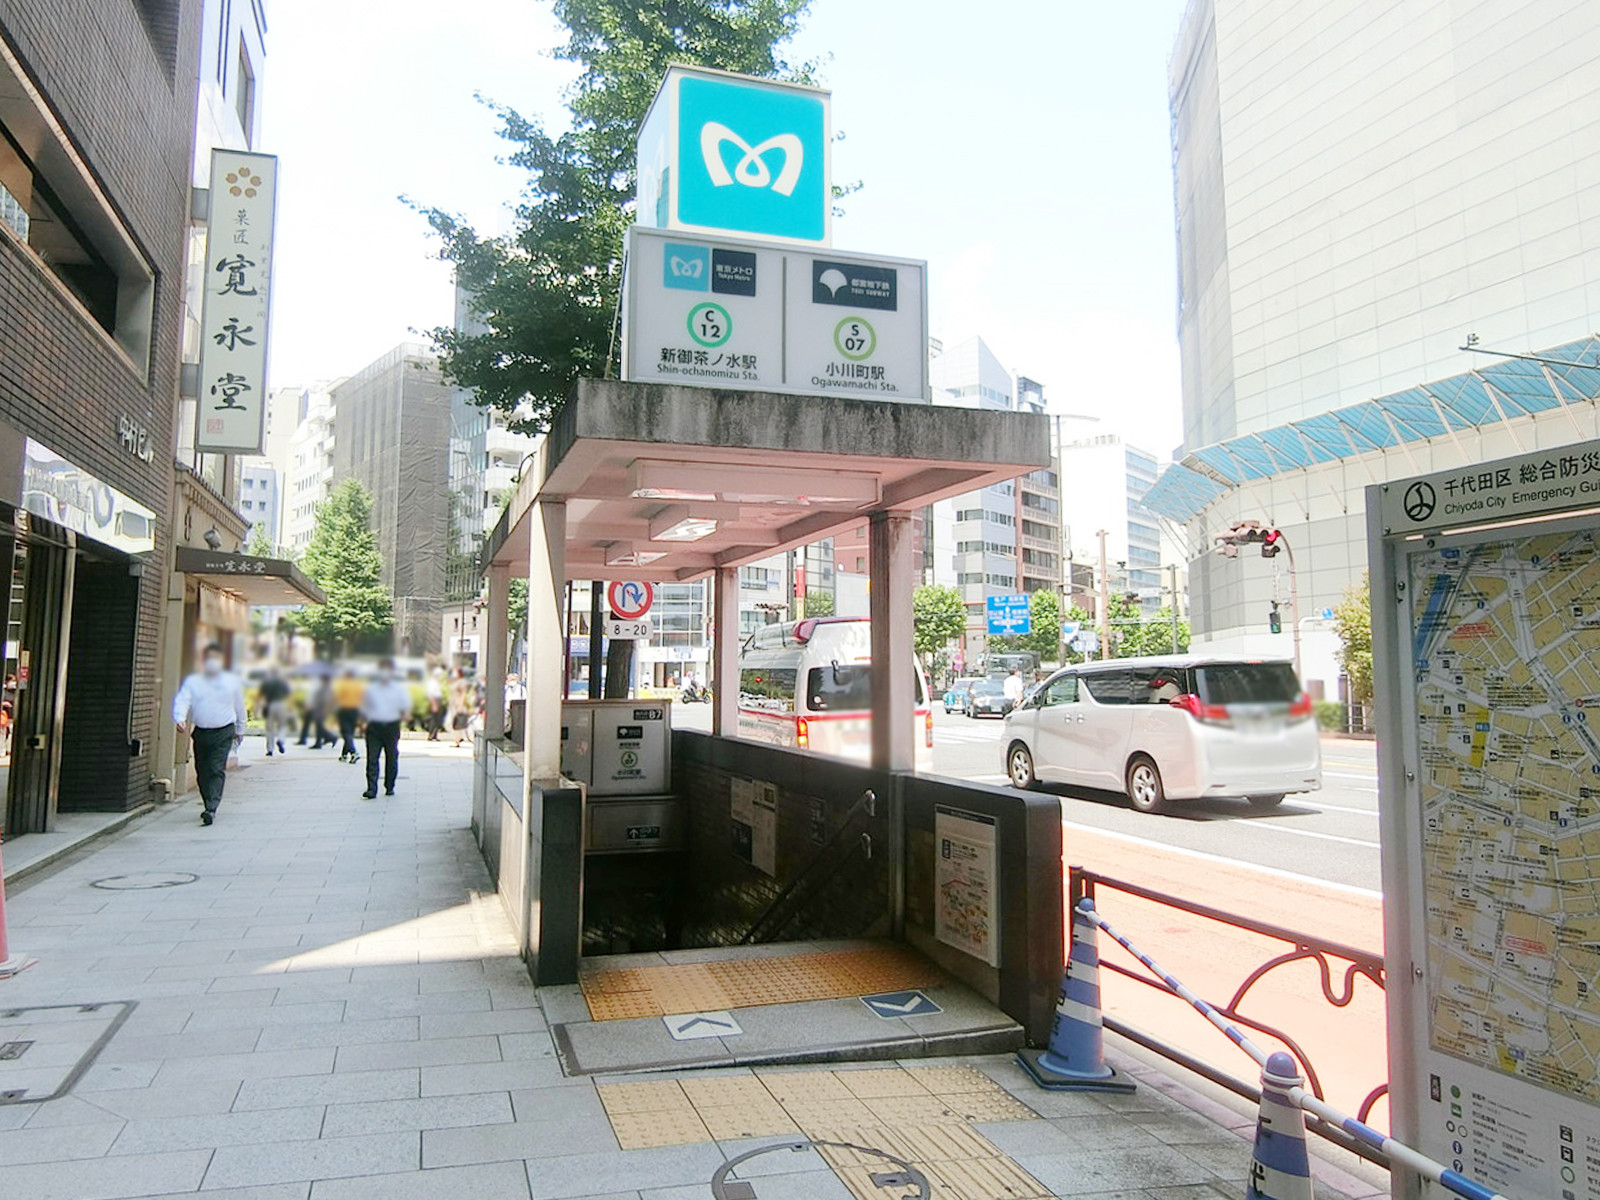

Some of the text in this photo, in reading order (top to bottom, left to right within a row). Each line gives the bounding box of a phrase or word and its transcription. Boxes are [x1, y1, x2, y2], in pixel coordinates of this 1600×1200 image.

[716, 264, 753, 276] 東京メトロ
[704, 310, 714, 323] C
[211, 253, 257, 411] 寛永堂
[700, 324, 721, 339] 12
[851, 324, 860, 336] S
[845, 338, 866, 352] 07
[660, 347, 757, 371] 新御茶ノ水駅
[656, 363, 760, 381] Shin-ochanomizu Sta.
[826, 361, 885, 381] 小川町駅
[811, 376, 899, 392] Ogawamachi Sta.
[1443, 451, 1600, 498] 千代田区 総合防災
[1444, 499, 1484, 515] Chiyoda
[1486, 495, 1507, 509] City
[1512, 483, 1576, 504] Emergency
